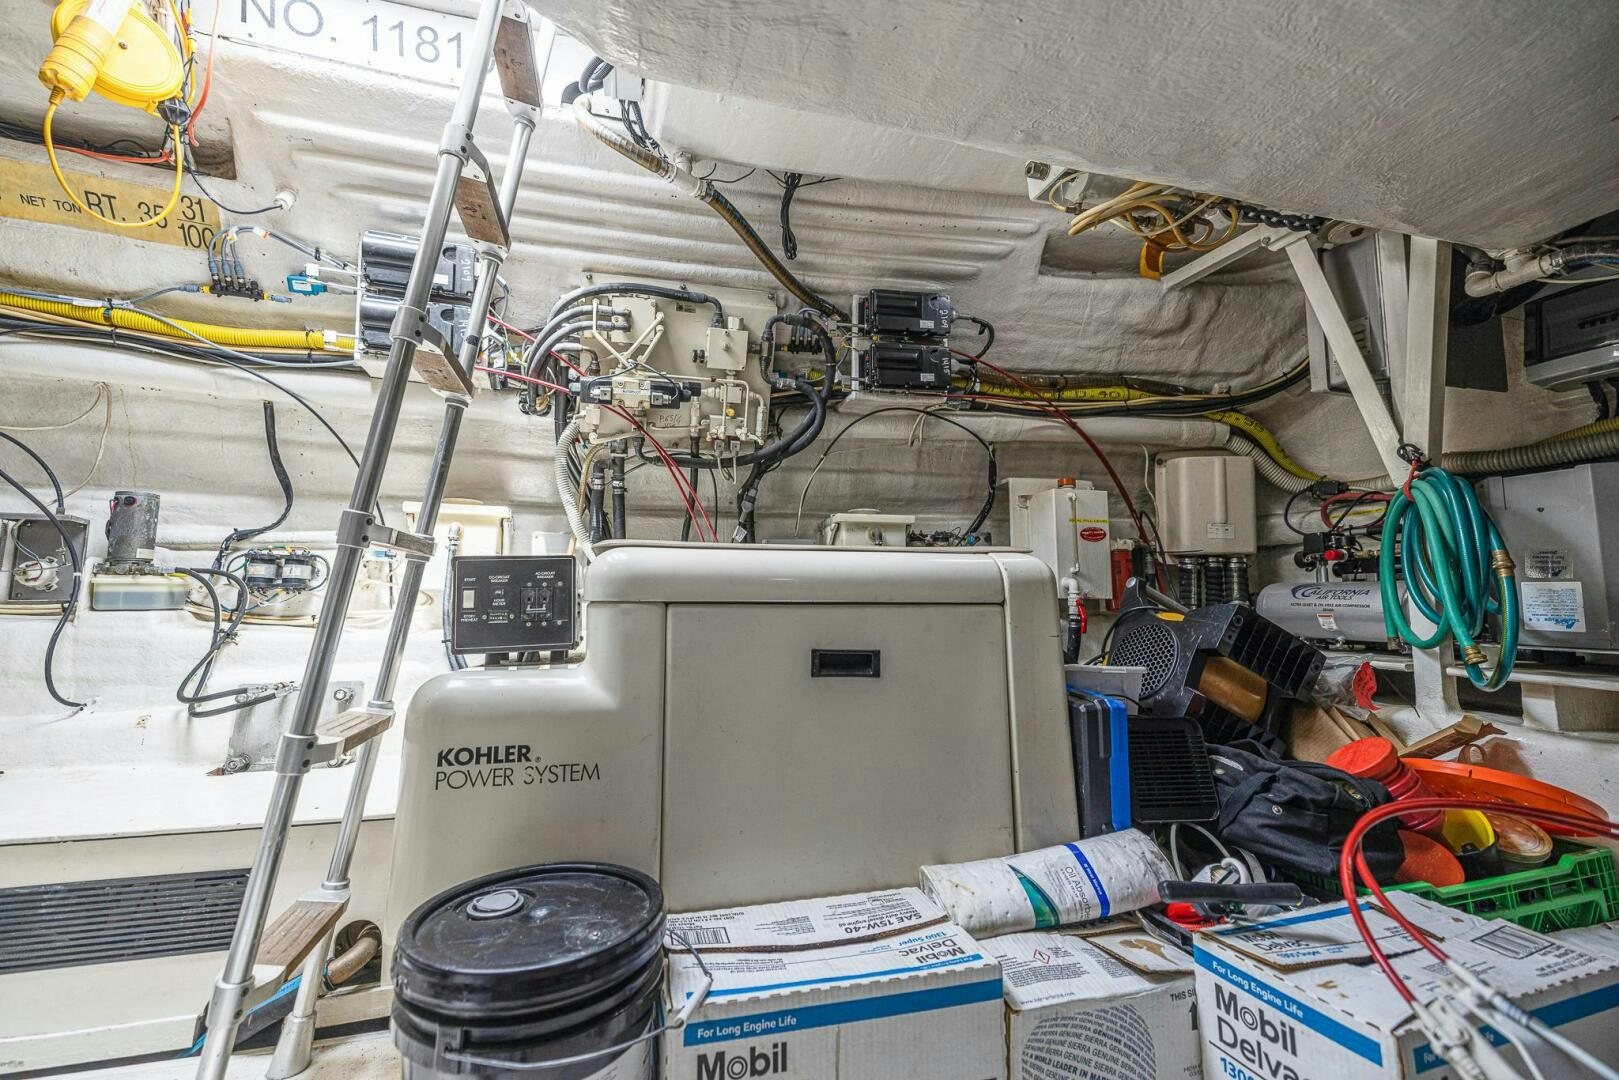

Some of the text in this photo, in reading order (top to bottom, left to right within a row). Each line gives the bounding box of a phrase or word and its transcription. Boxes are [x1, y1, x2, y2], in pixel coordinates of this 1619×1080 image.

[240, 0, 494, 74] NO. 1181
[19, 193, 46, 208] NET
[137, 201, 168, 229] 35
[177, 223, 215, 251] 100
[436, 744, 532, 768] KOHLER
[435, 762, 601, 791] POWER SYSTEM
[1065, 866, 1078, 879] Oil
[844, 916, 895, 935] 15W-40
[896, 912, 923, 925] SAE
[898, 938, 958, 957] Delvac
[915, 946, 966, 964] Mobil
[1170, 991, 1187, 1002] THIS
[1212, 960, 1304, 1019] For Long Engine Life
[697, 1014, 798, 1039] For Long Engine Life
[1214, 982, 1298, 1058] Mobil
[1083, 1035, 1107, 1048] SIERRA
[1093, 1028, 1123, 1045] GENUINE
[1216, 1014, 1311, 1080] Delva
[696, 1041, 788, 1080] Mobil
[1063, 1051, 1092, 1067] GENUINE
[1093, 1062, 1117, 1076] SIERRA
[1067, 1041, 1091, 1053] SIERRA
[1092, 1048, 1120, 1065] GENUINE
[1034, 1054, 1052, 1066] WORLD
[1052, 1060, 1077, 1075] LEADER
[1079, 1069, 1089, 1079] IN
